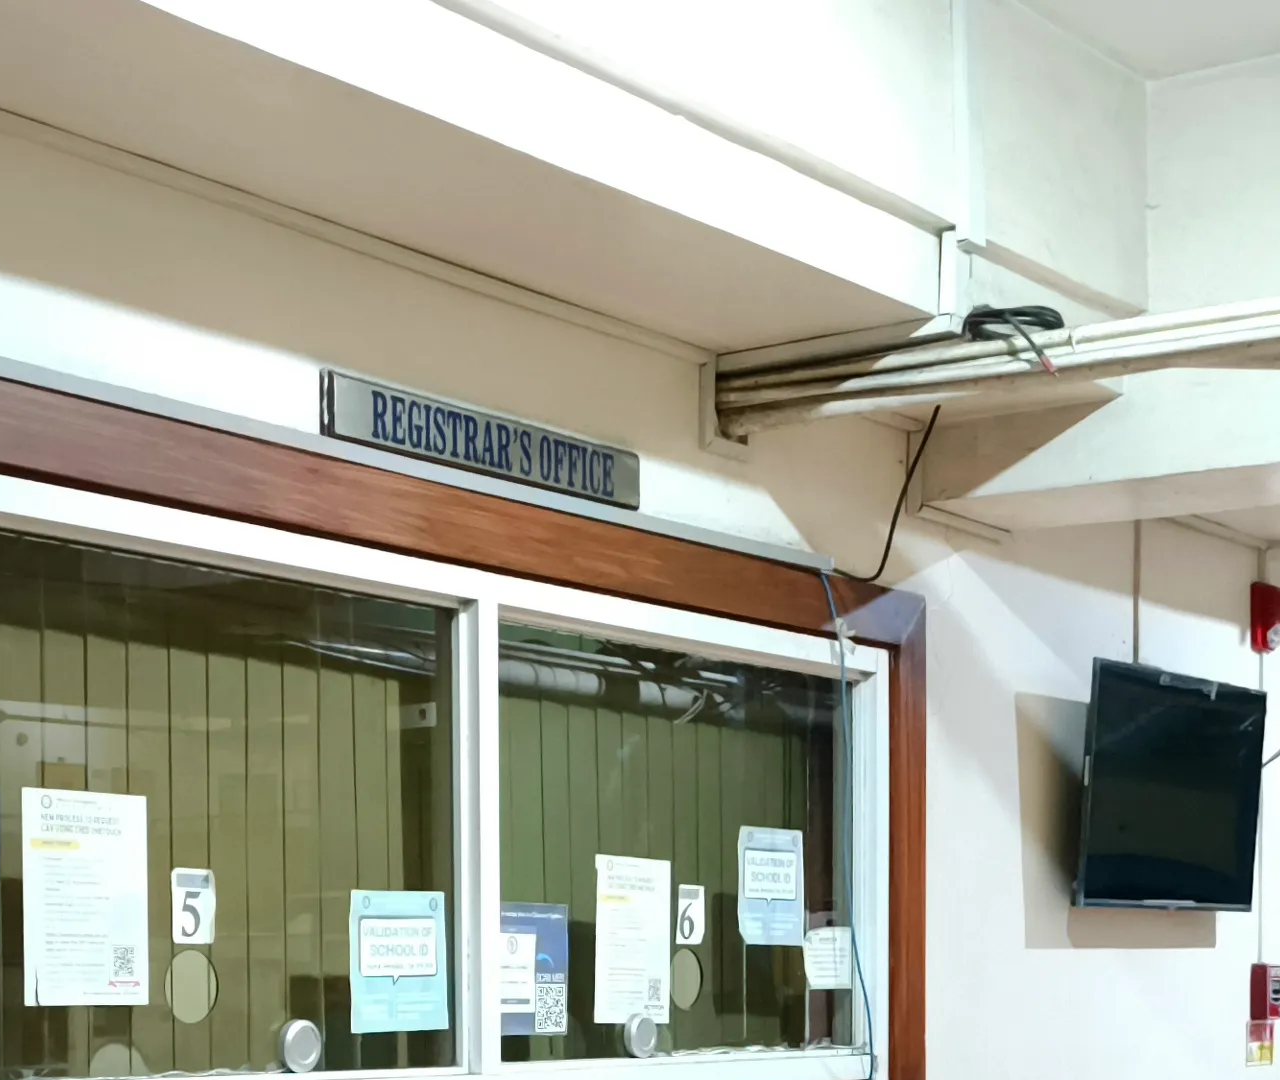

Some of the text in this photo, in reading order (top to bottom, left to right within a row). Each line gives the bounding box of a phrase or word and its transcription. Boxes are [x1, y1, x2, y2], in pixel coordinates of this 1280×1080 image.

[371, 389, 615, 498] REGISTRAR'S OFFICE
[181, 890, 202, 937] 5
[679, 902, 695, 940] 6
[370, 943, 416, 957] SCHOOL
